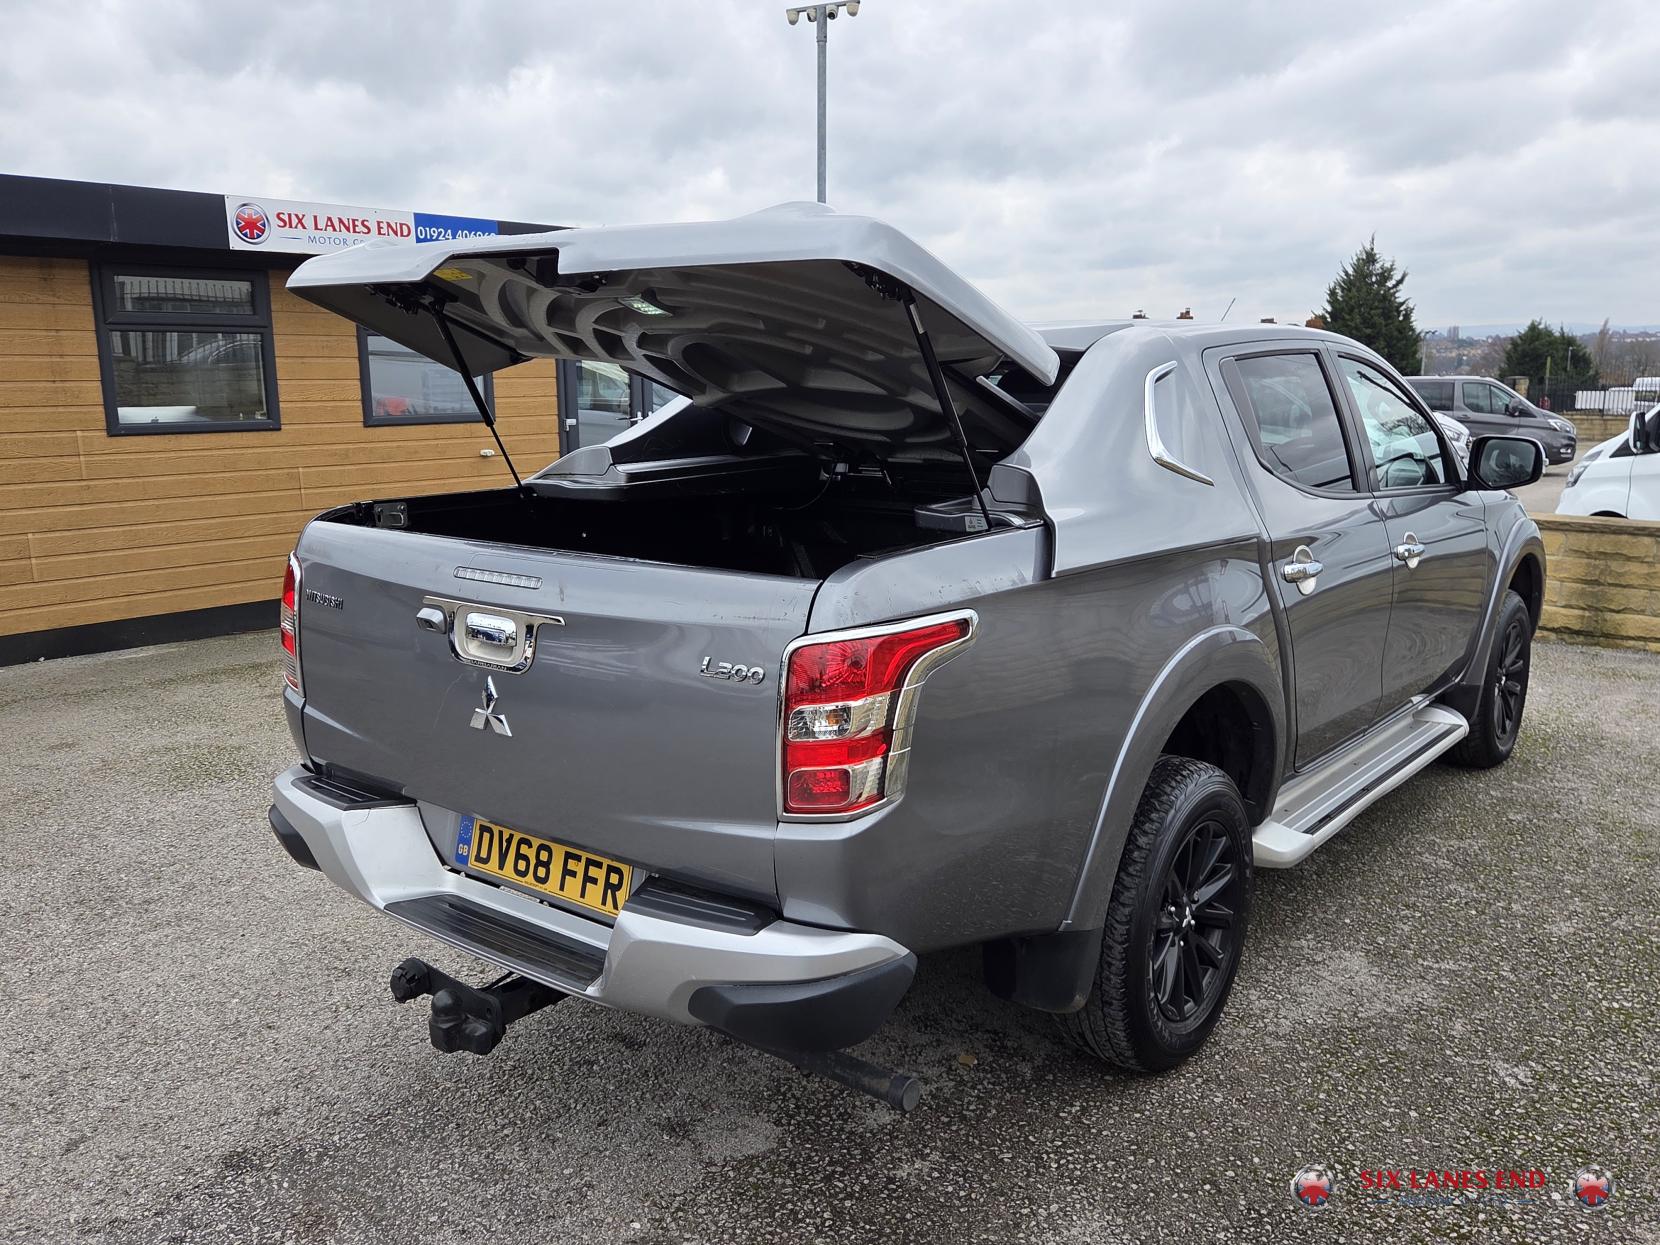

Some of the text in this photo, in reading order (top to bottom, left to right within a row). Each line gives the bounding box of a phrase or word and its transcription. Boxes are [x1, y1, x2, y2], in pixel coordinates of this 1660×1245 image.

[276, 212, 411, 238] SIX LANES END
[417, 226, 452, 240] 01924
[307, 235, 349, 246] MOTOR
[458, 843, 468, 855] GB
[474, 824, 624, 911] DV68 FFR
